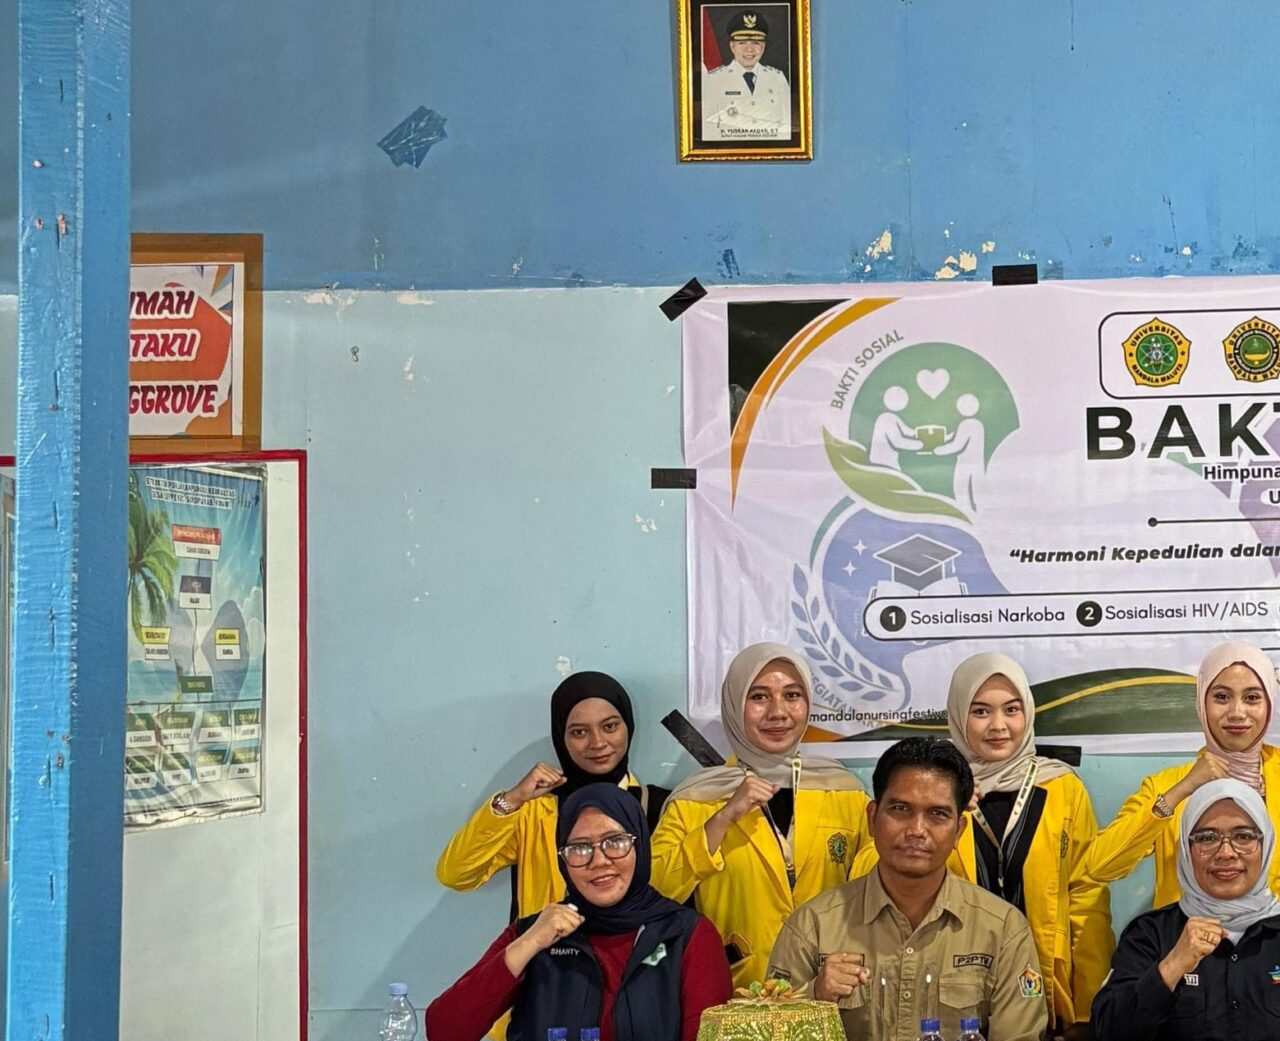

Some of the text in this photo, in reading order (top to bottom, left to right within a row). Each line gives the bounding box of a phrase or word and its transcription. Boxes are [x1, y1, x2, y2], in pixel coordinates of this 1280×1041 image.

[831, 329, 904, 410] BAKTI SOSIAL
[1111, 543, 1223, 563] Kepedulian
[888, 611, 897, 625] 1
[911, 608, 993, 625] Sosialisasi
[998, 606, 1065, 622] Narkoba
[1084, 606, 1095, 621] 2
[1105, 603, 1187, 620] Sosialisasi
[1192, 601, 1268, 621] HIV/AIDS
[810, 671, 853, 713] EGIATA
